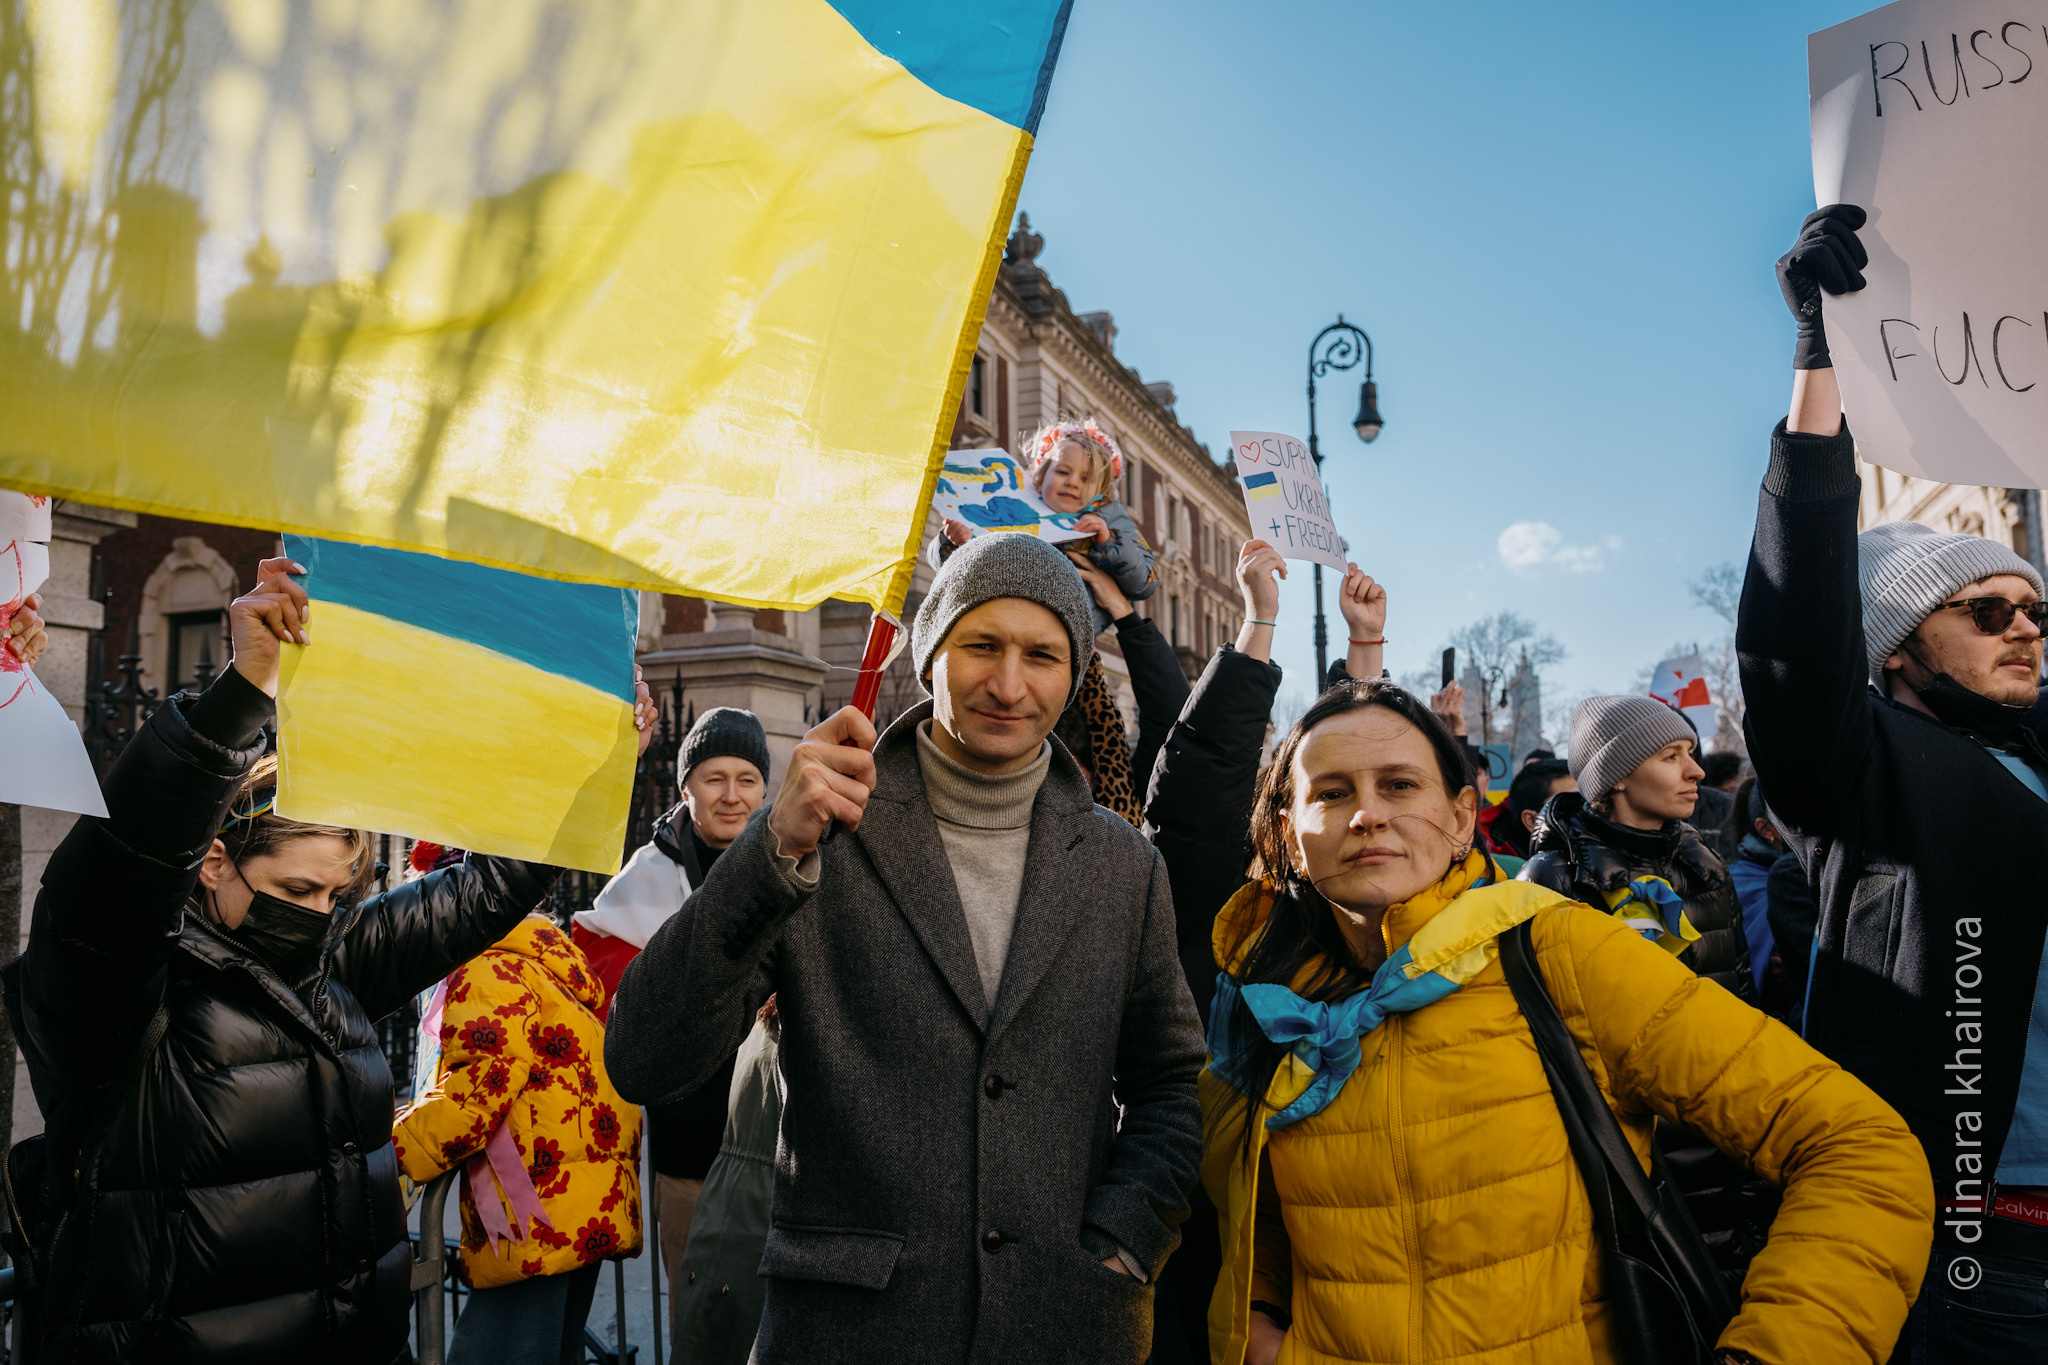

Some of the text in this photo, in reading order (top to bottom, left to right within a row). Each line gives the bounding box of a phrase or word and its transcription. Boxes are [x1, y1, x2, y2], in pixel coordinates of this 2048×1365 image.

[1870, 22, 2048, 117] RUSS
[1880, 311, 2048, 392] FUC
[1269, 517, 1281, 538] +
